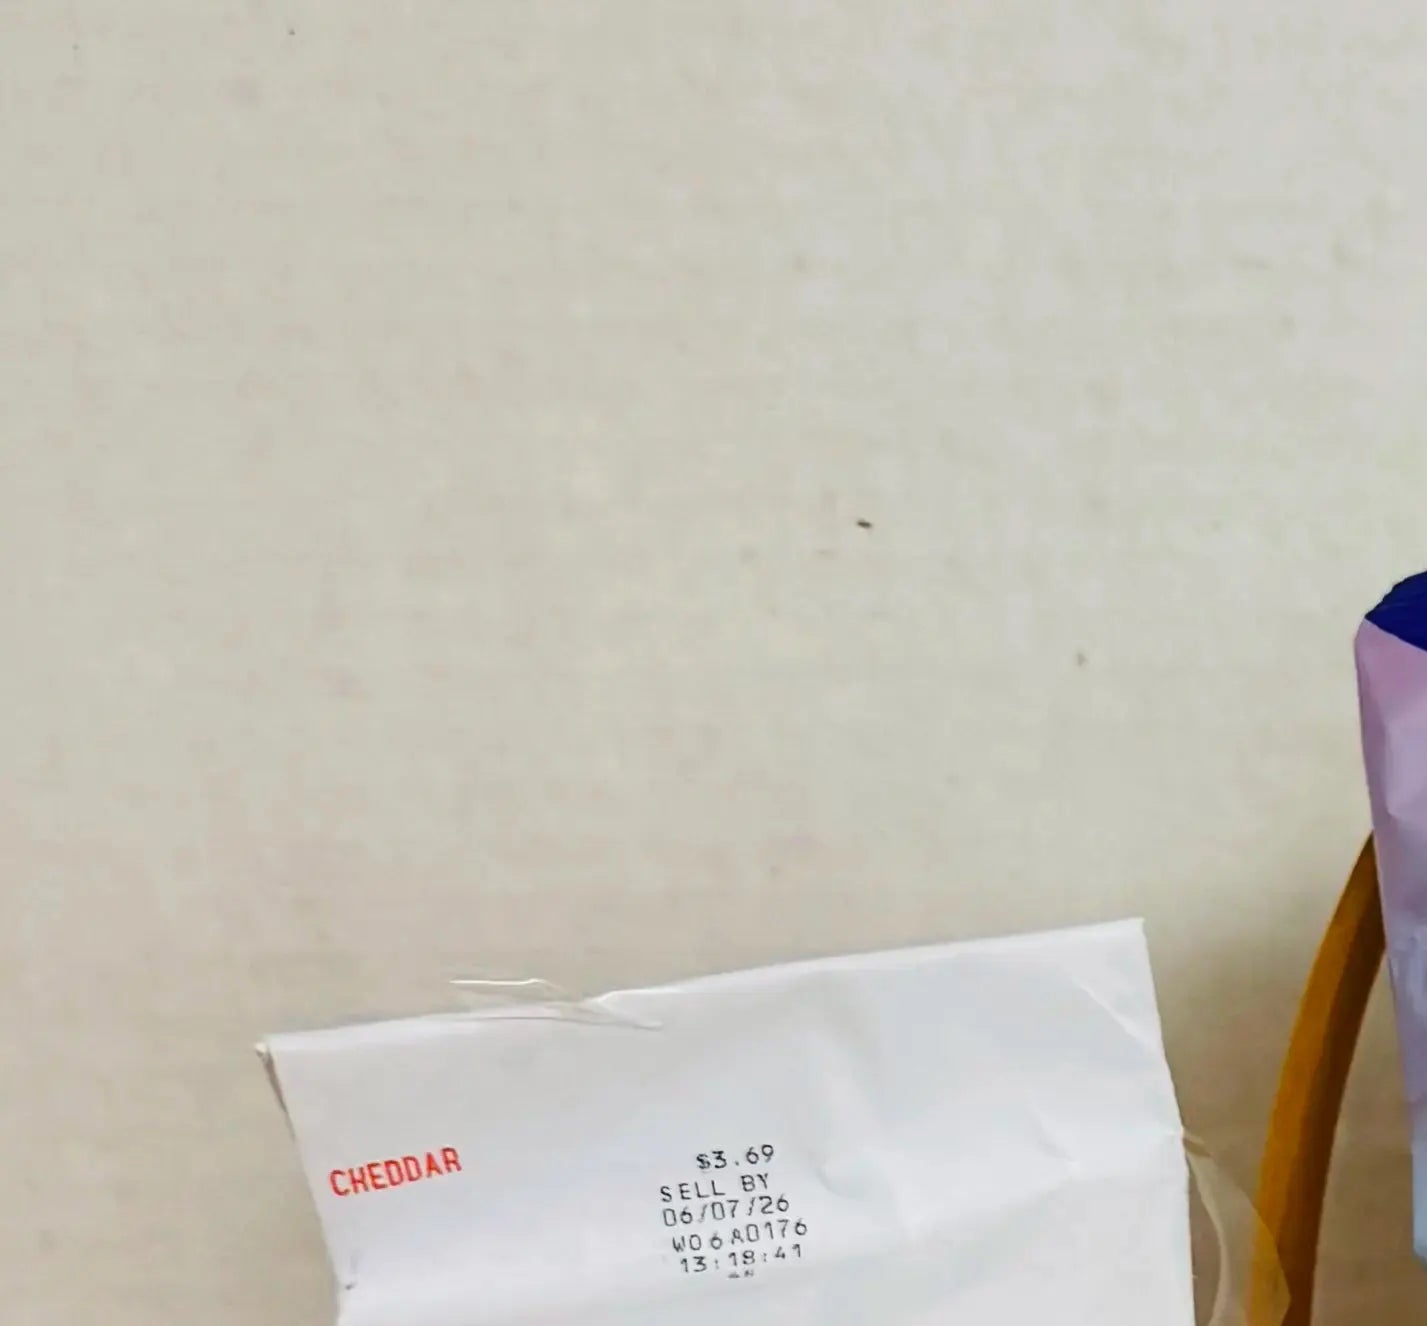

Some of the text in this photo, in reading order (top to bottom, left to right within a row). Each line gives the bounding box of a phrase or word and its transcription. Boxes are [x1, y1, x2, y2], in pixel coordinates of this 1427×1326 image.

[696, 1144, 774, 1169] $3.69
[330, 1148, 463, 1197] CHEDDAR
[660, 1173, 768, 1202] SELL BY
[663, 1194, 789, 1227] 06/07/26
